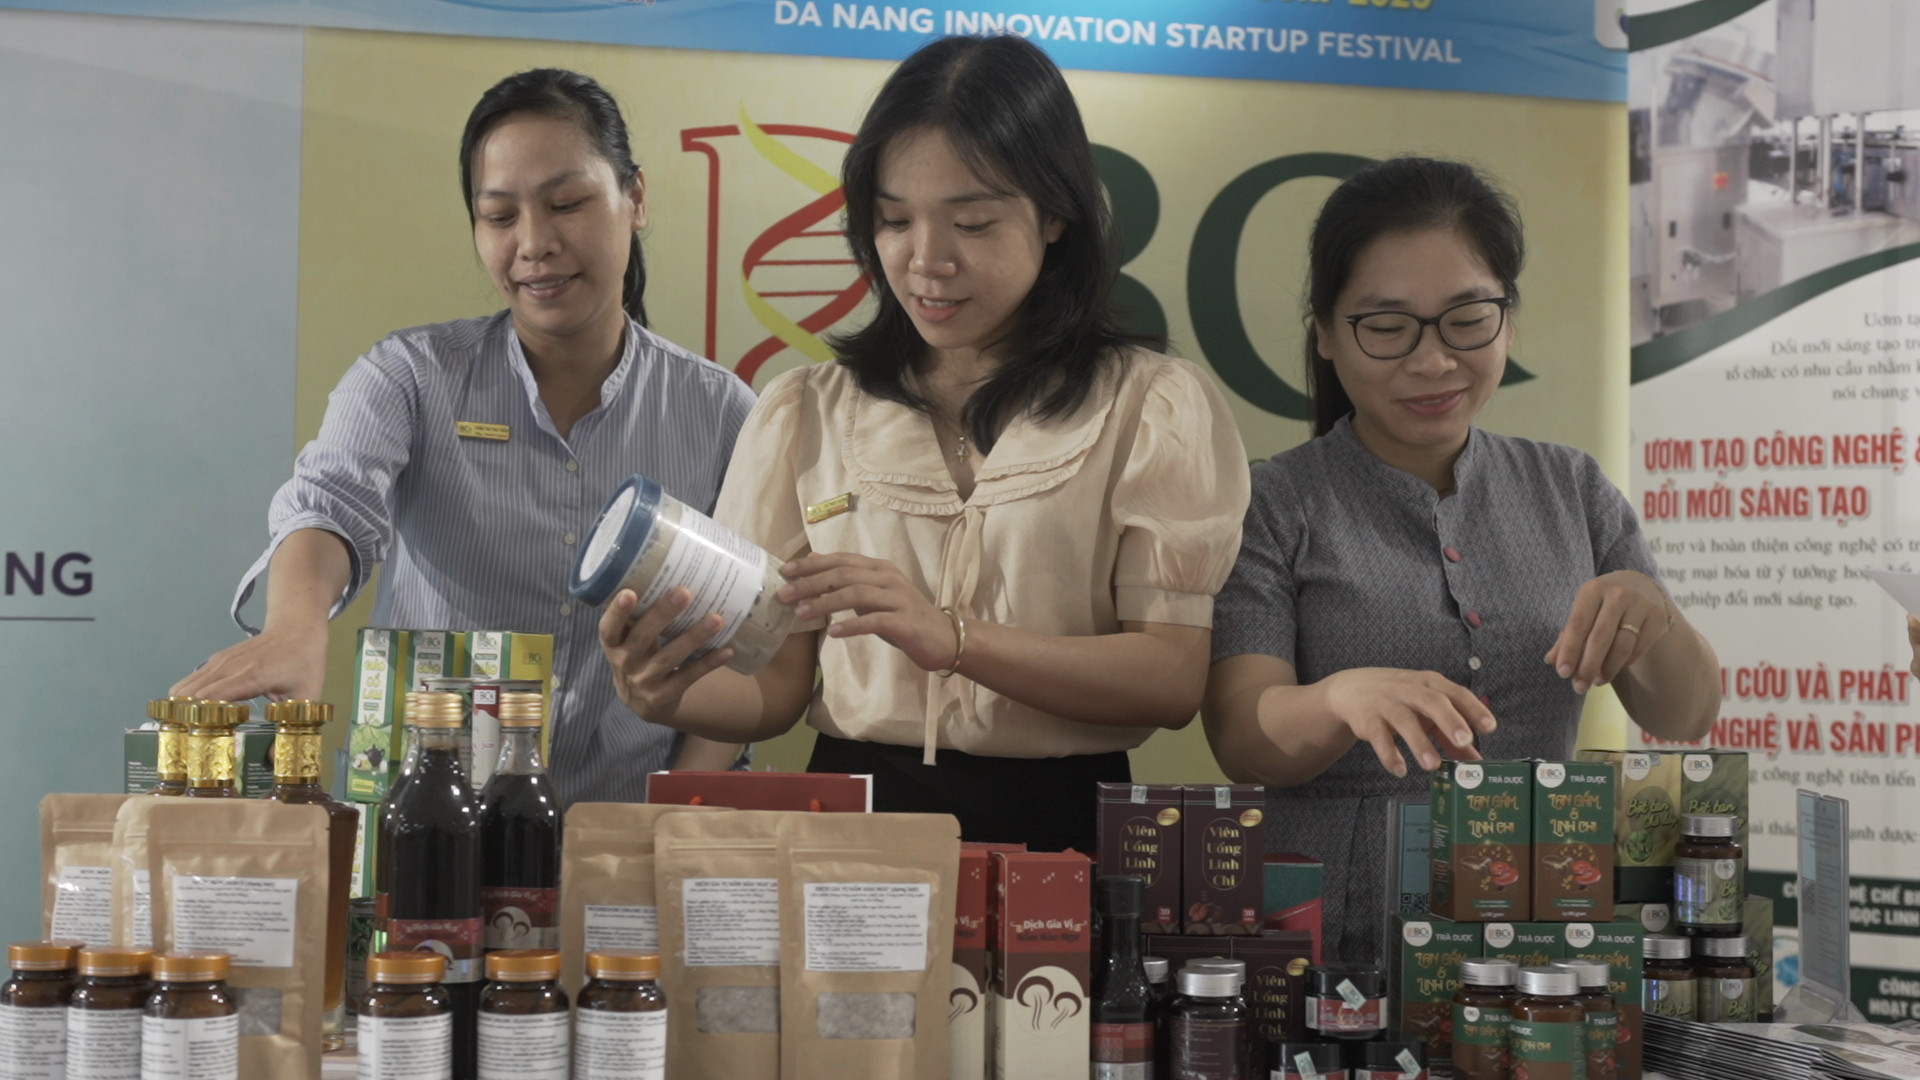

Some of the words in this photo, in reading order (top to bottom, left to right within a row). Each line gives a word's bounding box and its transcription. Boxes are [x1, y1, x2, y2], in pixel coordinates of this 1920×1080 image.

[774, 1, 822, 27] DA
[833, 4, 934, 34] NANG
[944, 10, 1156, 47] INNOVATION
[1166, 23, 1309, 54] STARTUP
[1318, 31, 1462, 63] FESTIVAL
[1803, 362, 1831, 377] nhu
[1861, 384, 1909, 402] chung
[1644, 437, 1693, 470] ƯƠM
[1700, 437, 1745, 475] TẠO
[1754, 430, 1823, 467] CÔNG
[1833, 426, 1904, 472] NGHỆ
[1644, 478, 1679, 520] ĐỔI
[1686, 482, 1732, 519] MỚI
[1740, 480, 1809, 518] SÁNG
[1818, 486, 1868, 526] TẠO
[1690, 538, 1706, 553] và
[1711, 537, 1746, 553] hoàn
[1752, 537, 1789, 555] thiện
[1795, 537, 1832, 556] công
[1839, 536, 1877, 556] nghệ
[1883, 537, 1903, 552] có
[5, 551, 93, 596] NG
[1754, 591, 1782, 606] mới
[1787, 591, 1823, 611] sáng
[1735, 660, 1788, 699] CỨU
[1796, 662, 1831, 700] VÀ
[1840, 663, 1909, 702] PHÁT
[1711, 712, 1779, 757] NGHỆ
[1787, 713, 1821, 751] VÀ
[1830, 711, 1887, 755] SẢN
[1763, 768, 1801, 786] công
[1806, 768, 1845, 787] nghệ
[1210, 825, 1239, 838] Viên
[1209, 858, 1239, 870] Linh
